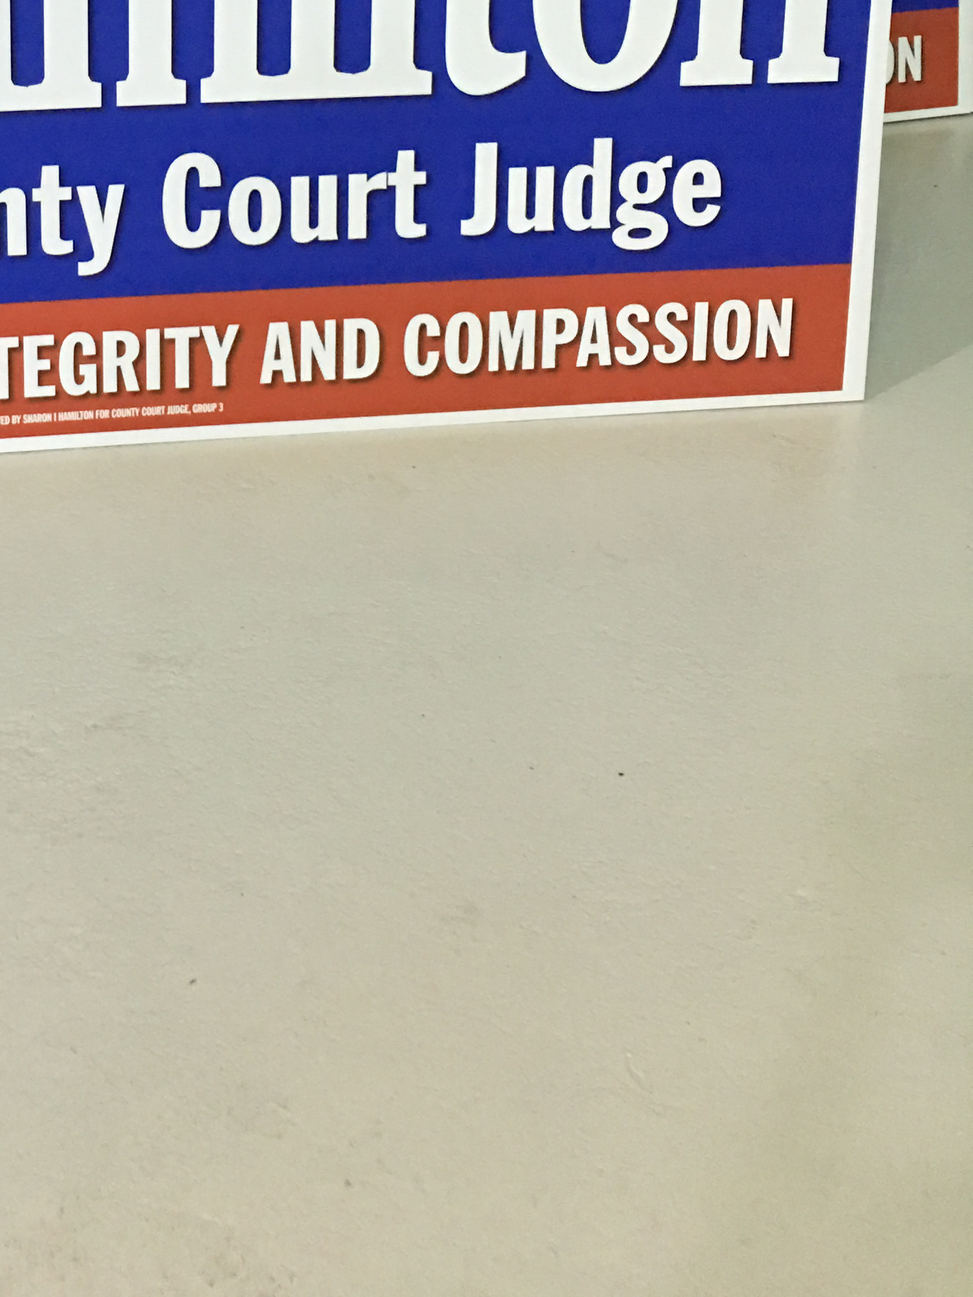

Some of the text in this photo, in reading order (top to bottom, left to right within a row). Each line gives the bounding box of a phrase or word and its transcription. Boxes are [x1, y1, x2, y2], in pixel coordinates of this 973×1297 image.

[163, 150, 427, 249] Court
[461, 137, 722, 251] Judge
[259, 317, 380, 385] AND
[403, 297, 793, 377] COMPASSION
[11, 415, 21, 425] BY
[23, 412, 52, 423] SHARON
[58, 410, 95, 421] HAMILTON
[95, 409, 110, 419] FOR
[111, 407, 140, 418] COUNTY
[141, 405, 166, 416] COURT
[192, 403, 217, 413] GROUP
[218, 402, 224, 412] 3
